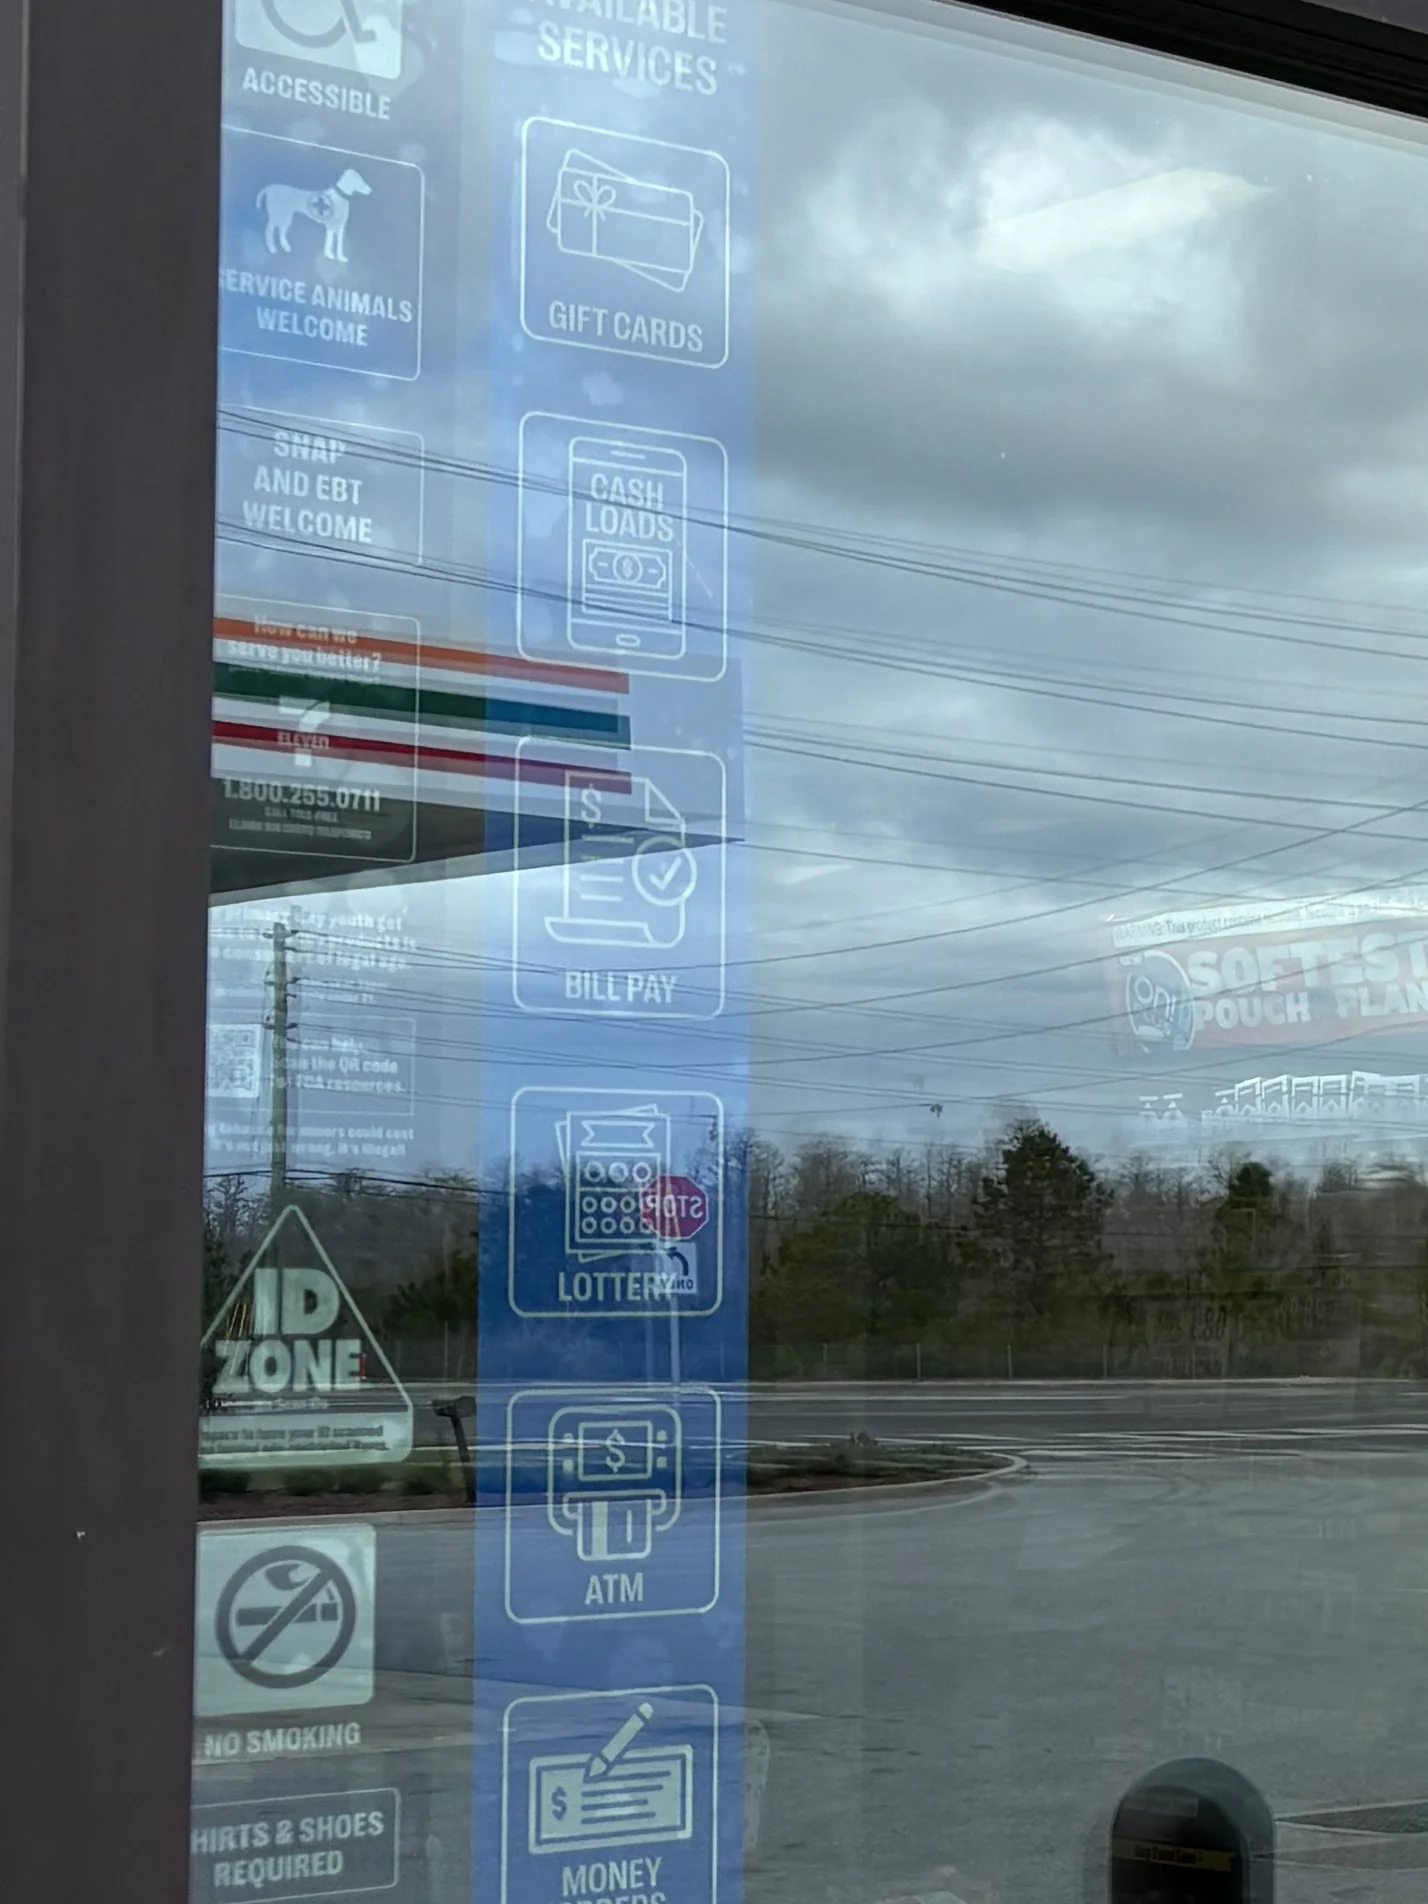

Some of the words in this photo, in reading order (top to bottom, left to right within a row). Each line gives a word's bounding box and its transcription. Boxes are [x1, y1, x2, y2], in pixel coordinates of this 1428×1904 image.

[537, 21, 718, 95] SERVICES
[241, 66, 391, 121] ACCESSIBLE
[311, 281, 413, 324] ANIMALS
[256, 306, 368, 348] WELCOME
[548, 300, 609, 338] GIFT
[613, 312, 704, 353] CARDS
[272, 431, 347, 463] SNAP
[252, 465, 310, 497] AND
[315, 473, 364, 506] EBT
[590, 473, 663, 510] CASH
[242, 499, 373, 544] WELCOME
[585, 504, 674, 543] LOADS
[228, 639, 277, 659] serve
[281, 645, 314, 665] you
[565, 971, 622, 1000] BILL
[627, 973, 678, 1003] PAY
[1195, 990, 1311, 1031] POUCH
[253, 1267, 341, 1335] ID
[557, 1271, 675, 1302] LOTTERY
[212, 1338, 362, 1394] ZONE
[585, 1572, 644, 1605] ATM
[204, 1731, 242, 1757] NO
[246, 1721, 362, 1754] SMOKING
[191, 1822, 269, 1854] HIRTS
[275, 1819, 294, 1846] &
[299, 1810, 385, 1843] SHOES
[213, 1849, 344, 1888] REQUIRED
[562, 1857, 662, 1896] MONEY
